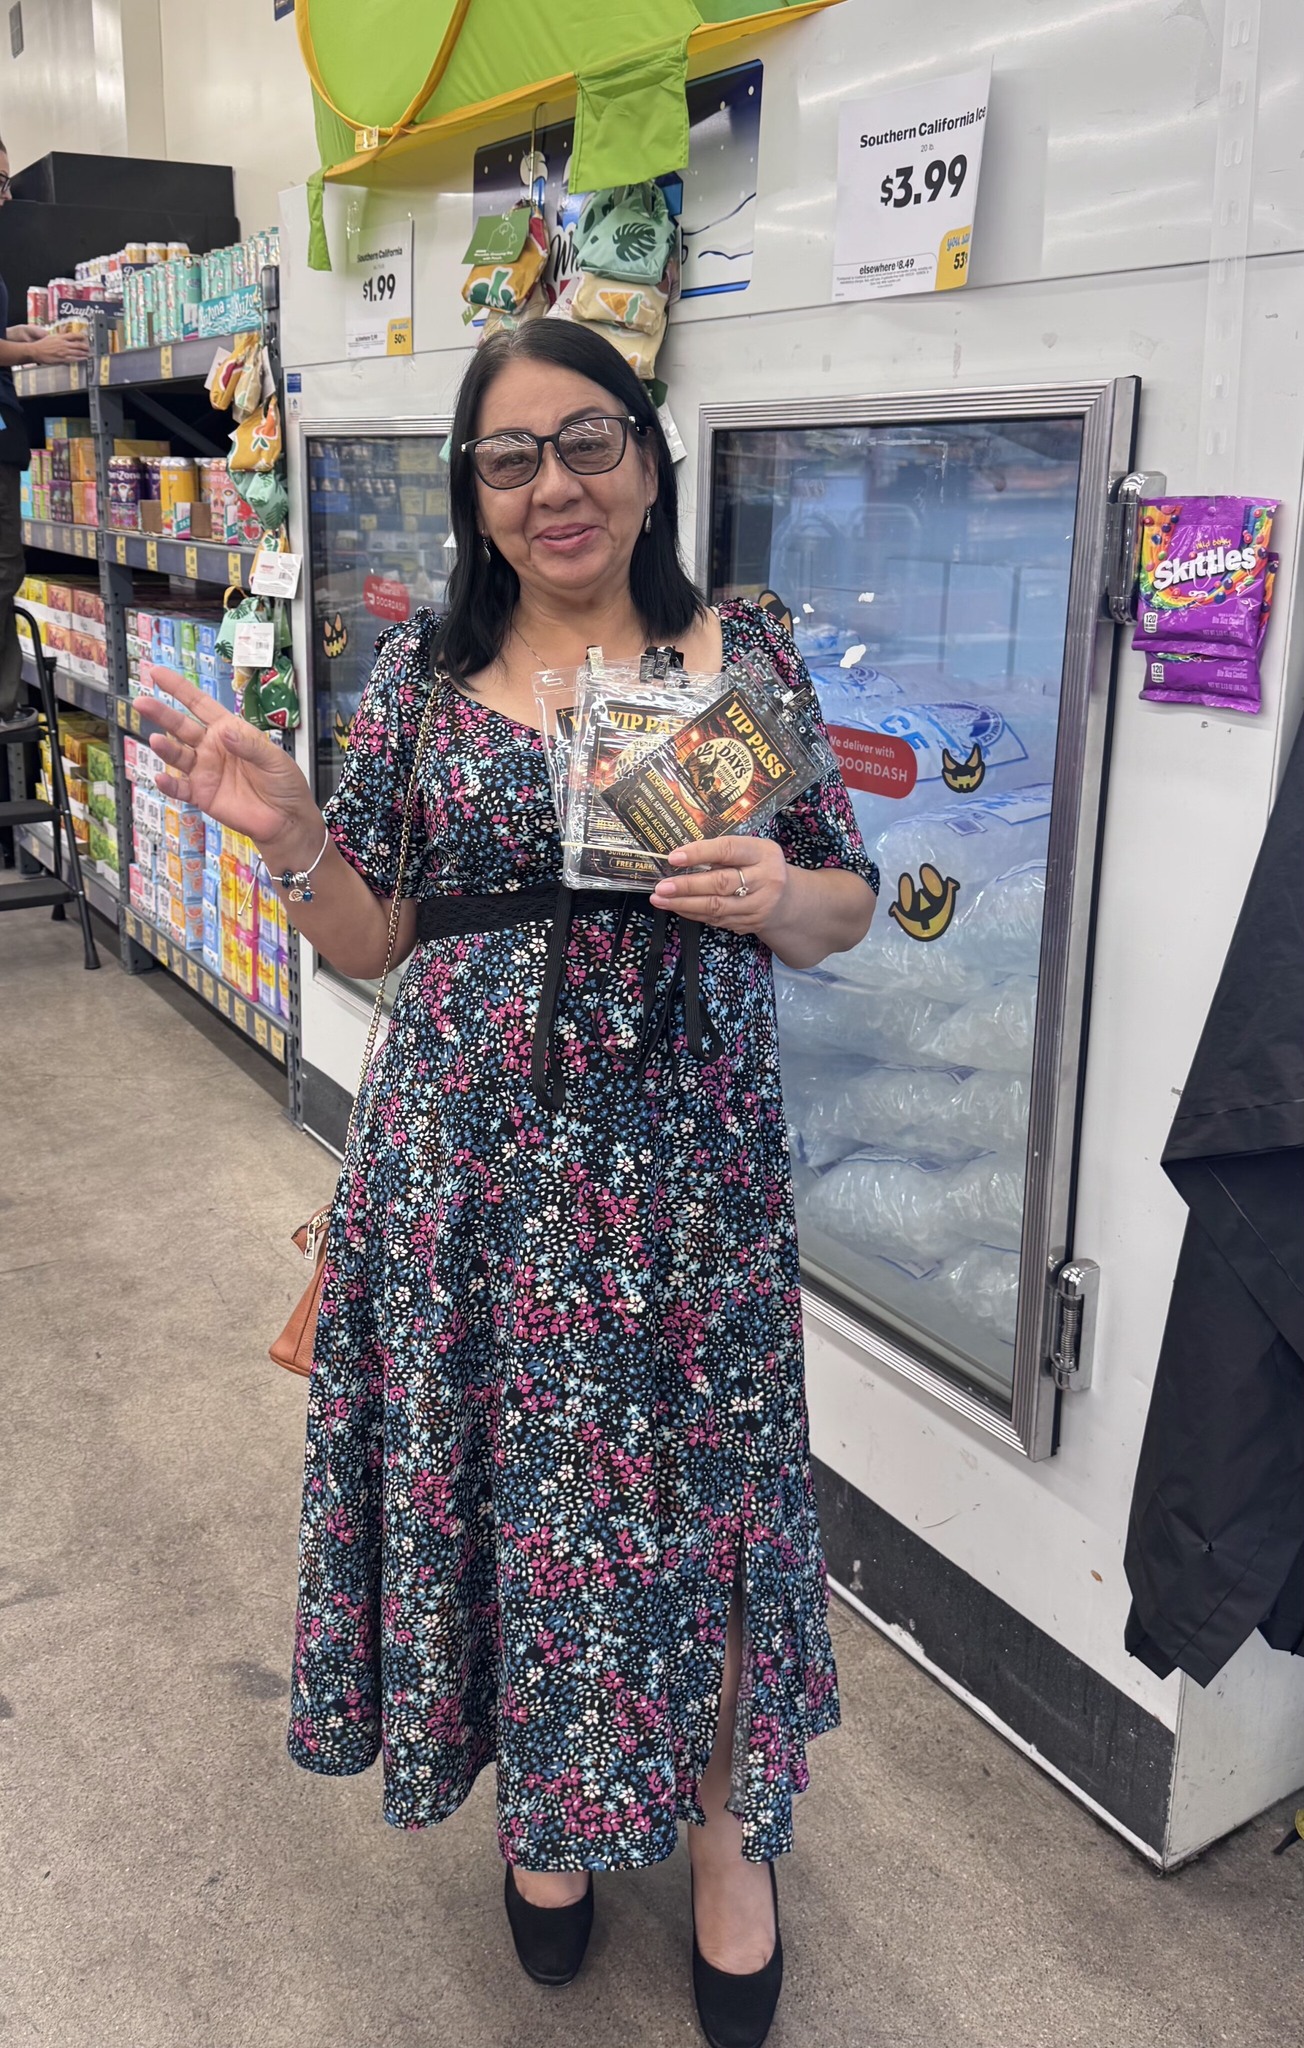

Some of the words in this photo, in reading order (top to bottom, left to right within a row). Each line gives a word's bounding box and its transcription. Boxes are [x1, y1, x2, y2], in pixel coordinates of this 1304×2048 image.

[859, 126, 917, 148] Southern
[918, 111, 975, 137] California
[880, 153, 968, 208] $3.99
[859, 262, 896, 275] elsewhere
[363, 273, 396, 302] $1.99
[1152, 546, 1257, 591] Skittles
[1145, 614, 1157, 624] 120
[1152, 664, 1163, 674] 120
[608, 710, 644, 730] VIP
[725, 700, 754, 734] VIP
[745, 730, 786, 779] PASS
[843, 738, 873, 754] deliver
[874, 745, 895, 759] with
[717, 745, 748, 779] DAYS
[727, 740, 752, 773] HESPERIA
[836, 754, 908, 783] DOORDASH
[645, 768, 675, 804] HESPERIA
[669, 800, 688, 820] DAYS
[683, 815, 705, 841] RODEO
[632, 810, 646, 828] FREE
[643, 826, 666, 853] PARKING
[636, 796, 656, 820] SUNDAY
[651, 817, 670, 840] ACCESS
[666, 836, 679, 850] ONL
[616, 860, 634, 868] FREE
